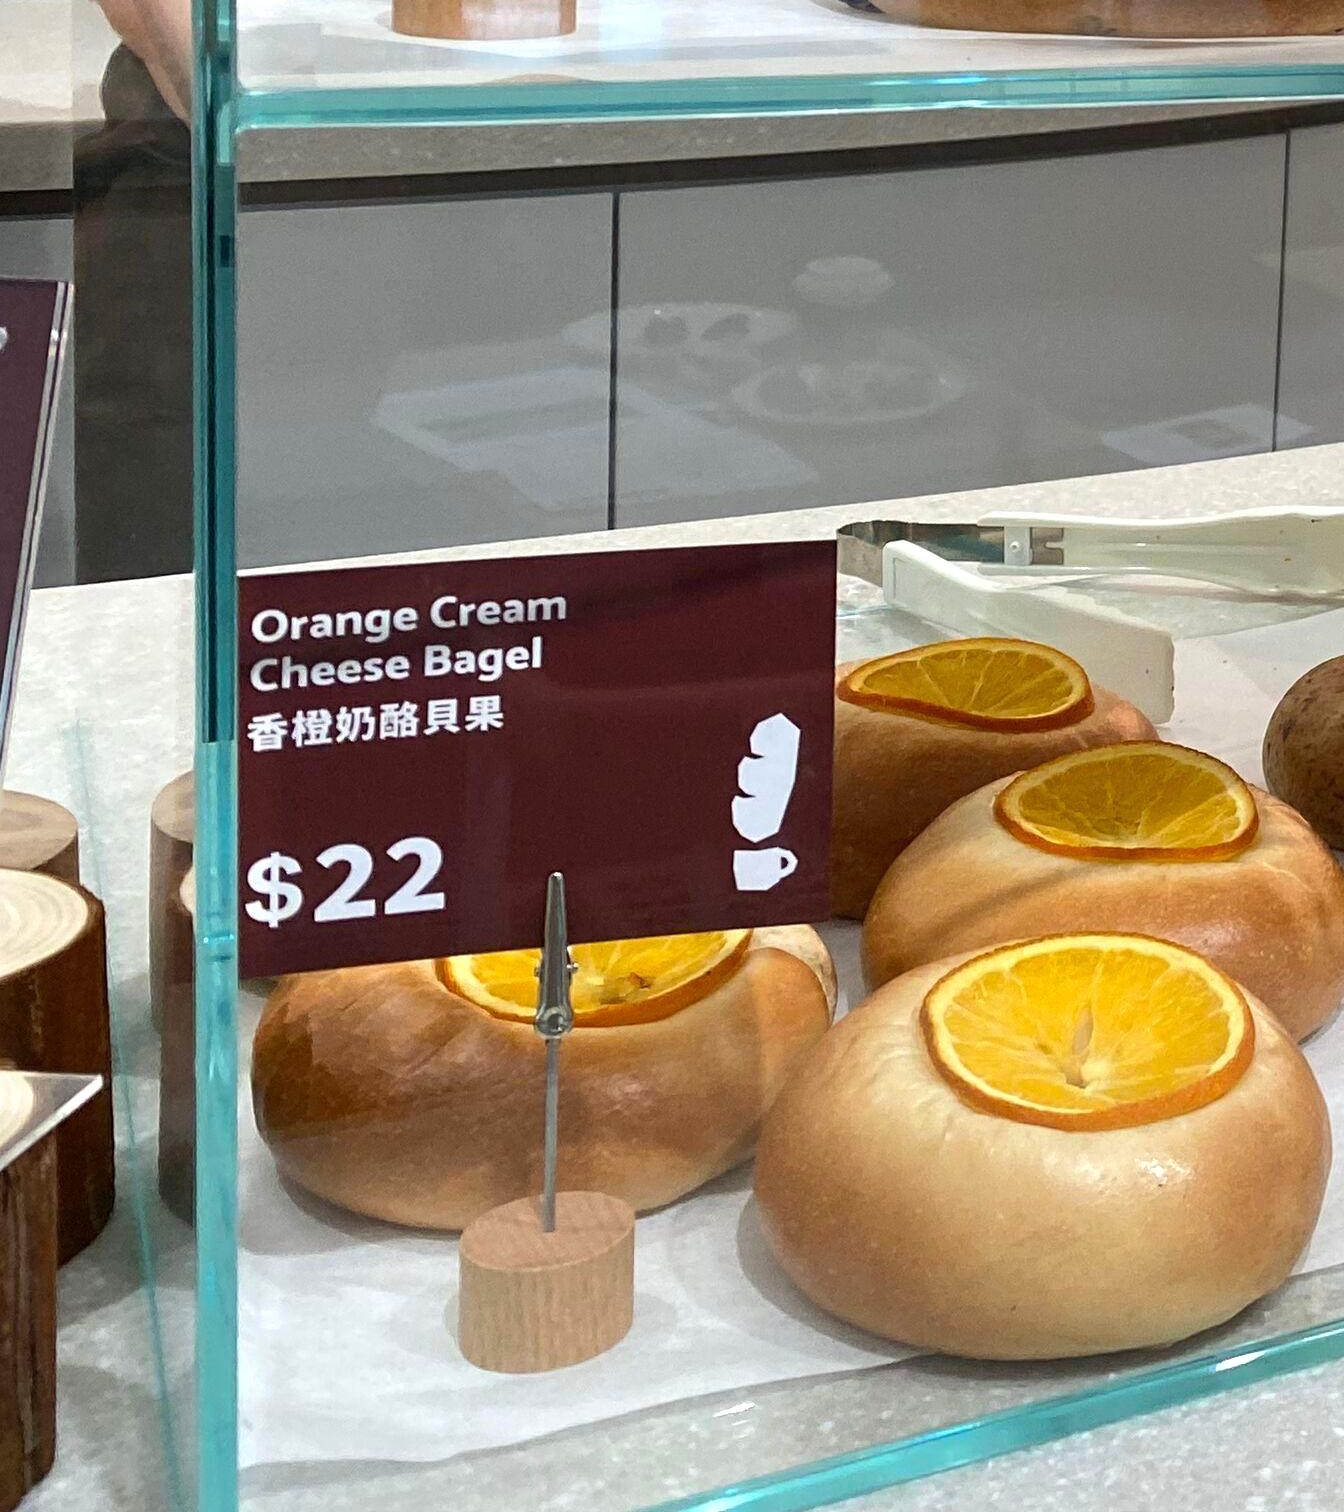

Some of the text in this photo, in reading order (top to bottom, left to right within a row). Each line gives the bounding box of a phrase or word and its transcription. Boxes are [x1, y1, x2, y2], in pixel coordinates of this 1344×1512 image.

[251, 595, 567, 643] Orange Cream
[249, 636, 543, 692] Cheese Bagel
[247, 695, 505, 752] 香橙奶酪貝果
[245, 836, 446, 929] $22
